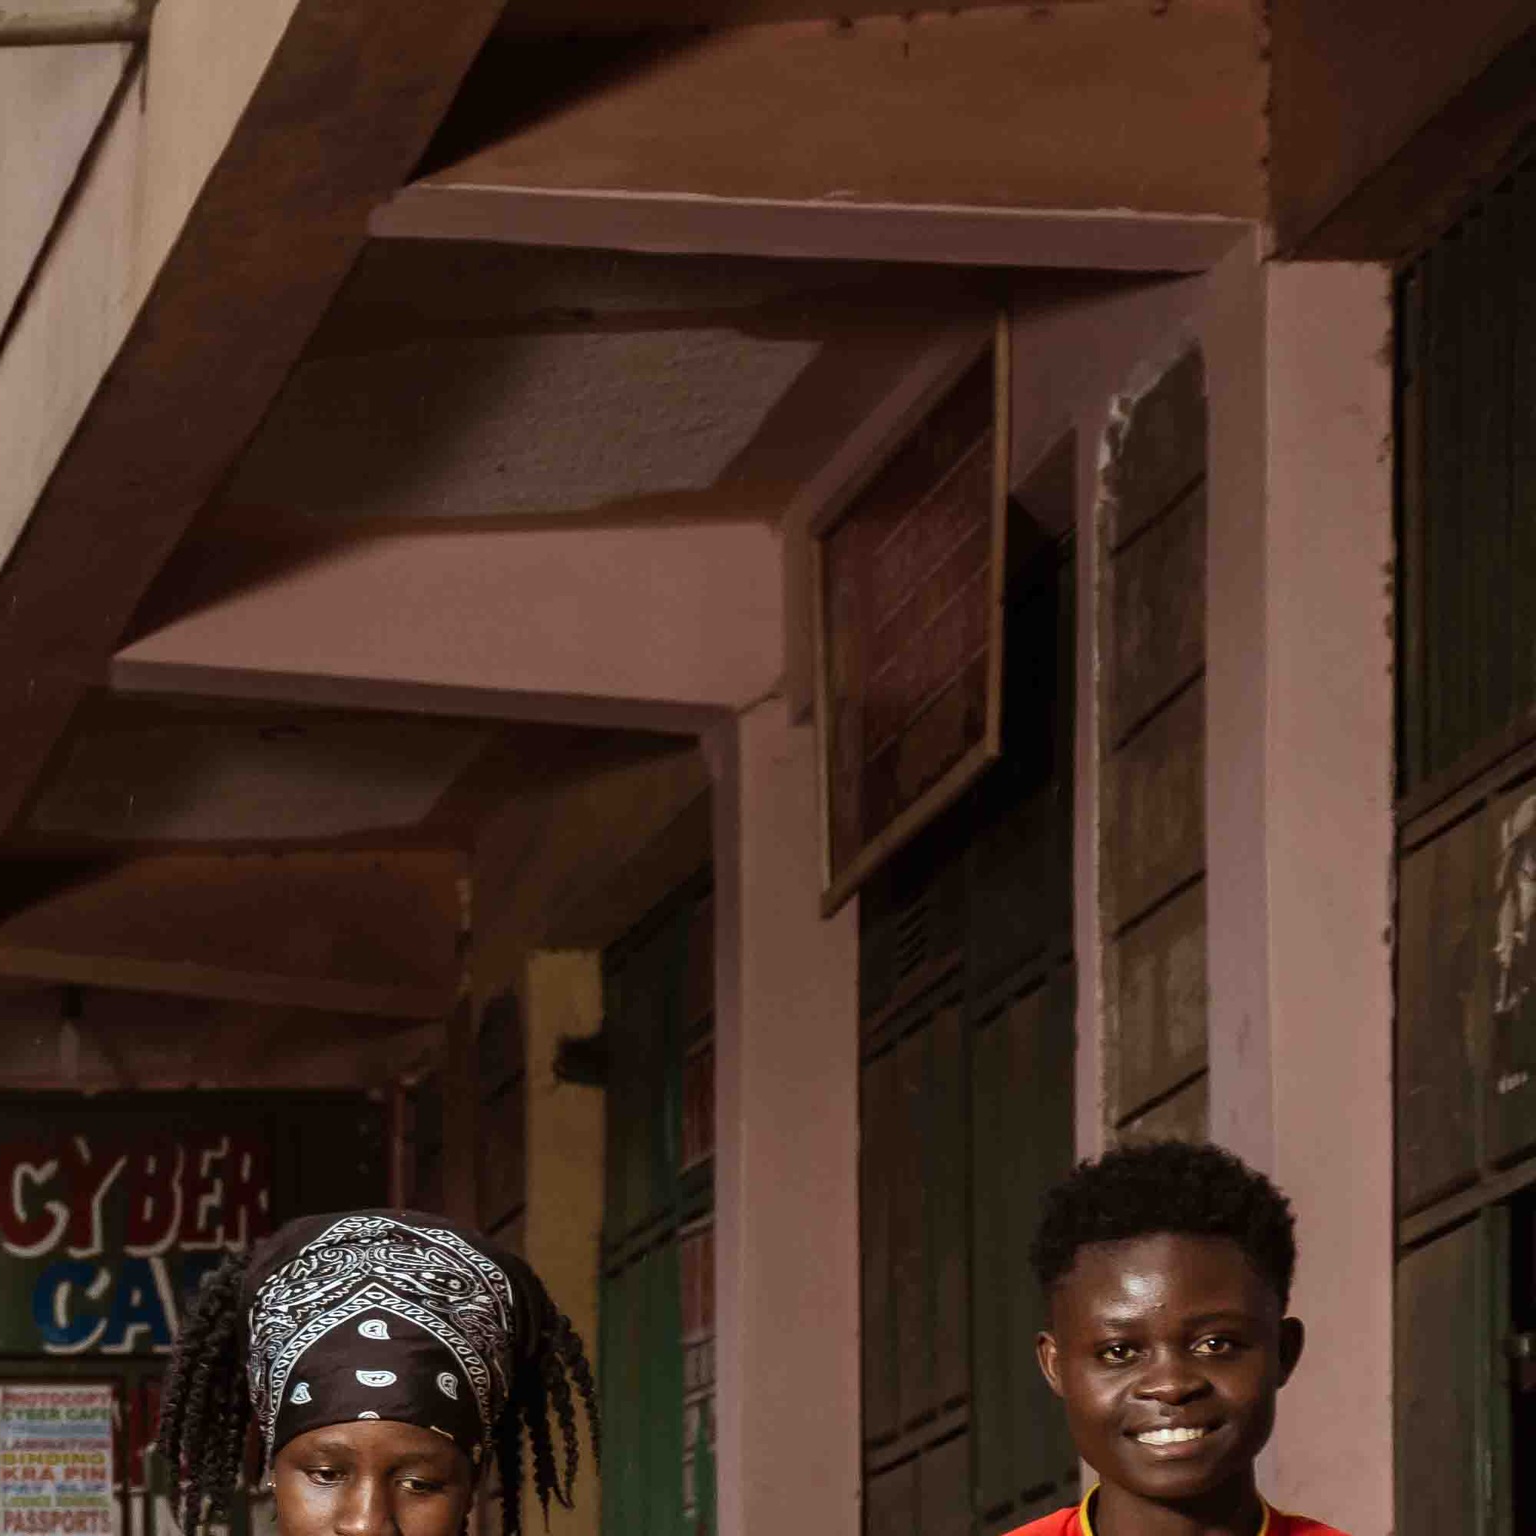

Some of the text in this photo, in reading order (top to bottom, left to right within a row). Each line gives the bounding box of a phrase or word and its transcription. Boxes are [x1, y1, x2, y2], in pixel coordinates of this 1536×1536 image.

[1, 1452, 106, 1465] BINDING
[1, 1466, 106, 1482] KRA PIN
[4, 1510, 111, 1534] PASSPORTS
